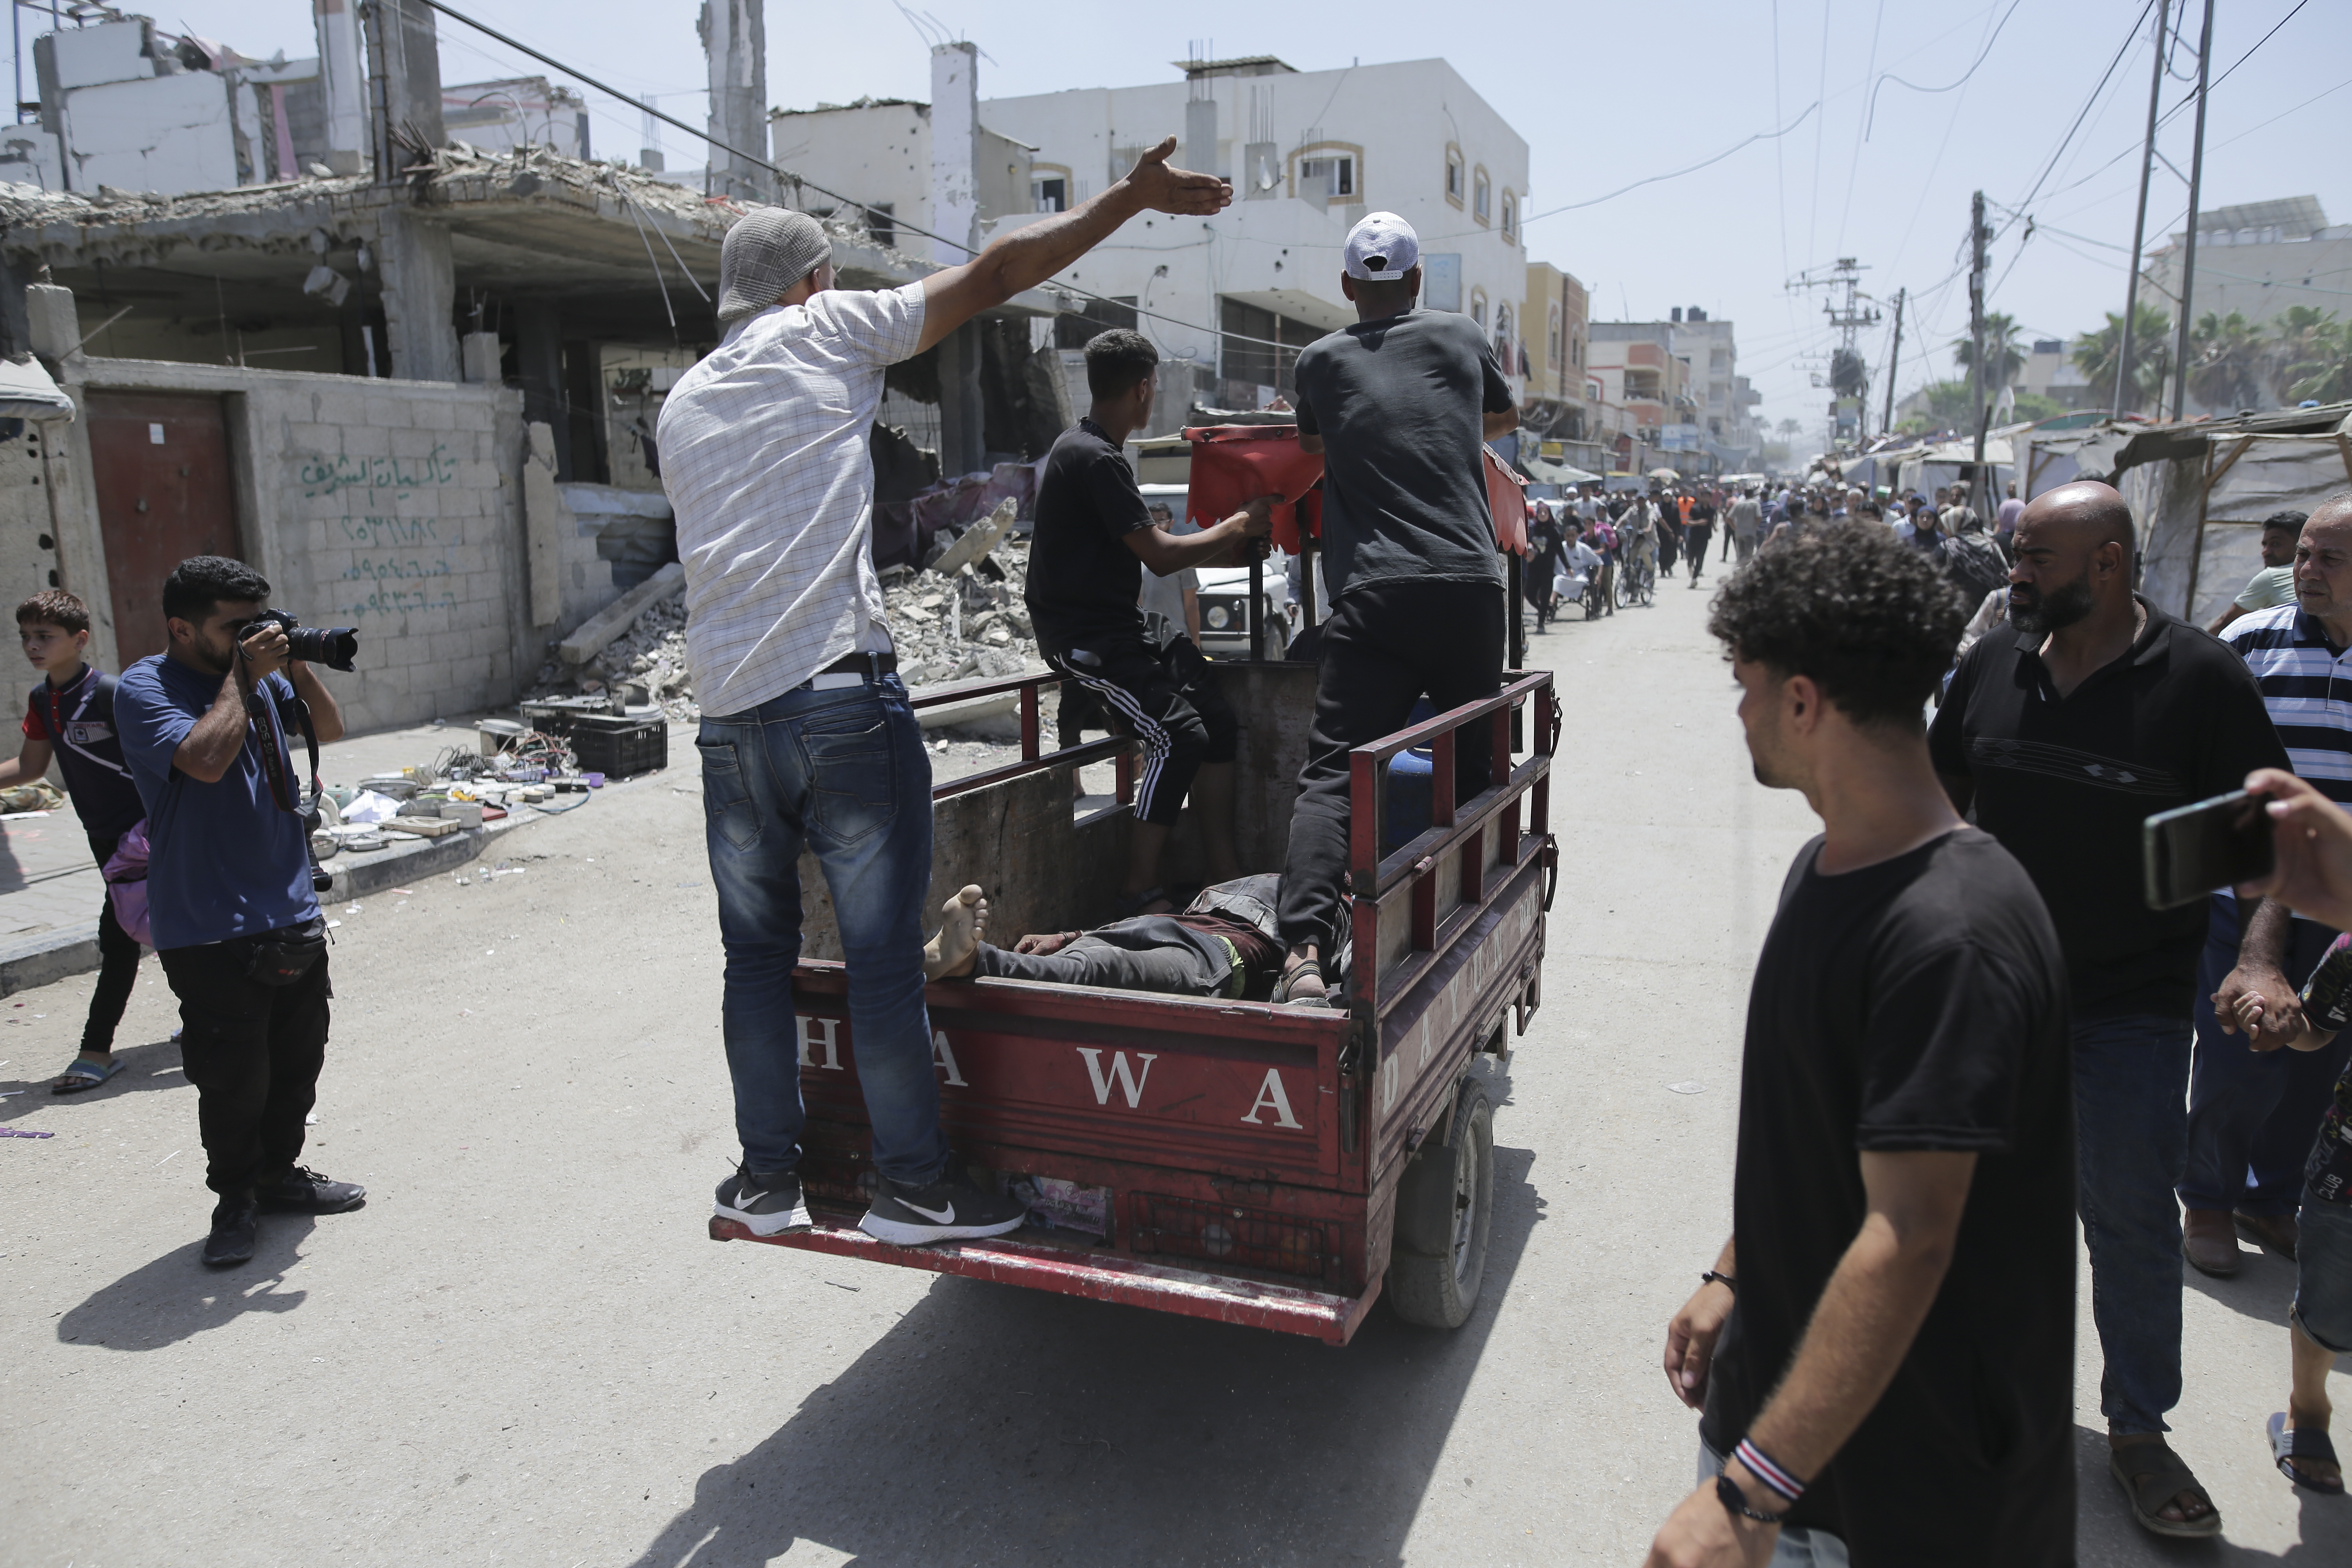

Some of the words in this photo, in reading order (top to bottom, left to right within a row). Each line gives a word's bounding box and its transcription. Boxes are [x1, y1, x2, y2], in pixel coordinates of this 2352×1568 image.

[257, 717, 270, 740] EOS
[264, 743, 274, 754] 5D
[1382, 920, 1503, 1115] DAYUN
[2318, 1173, 2344, 1200] CLUB
